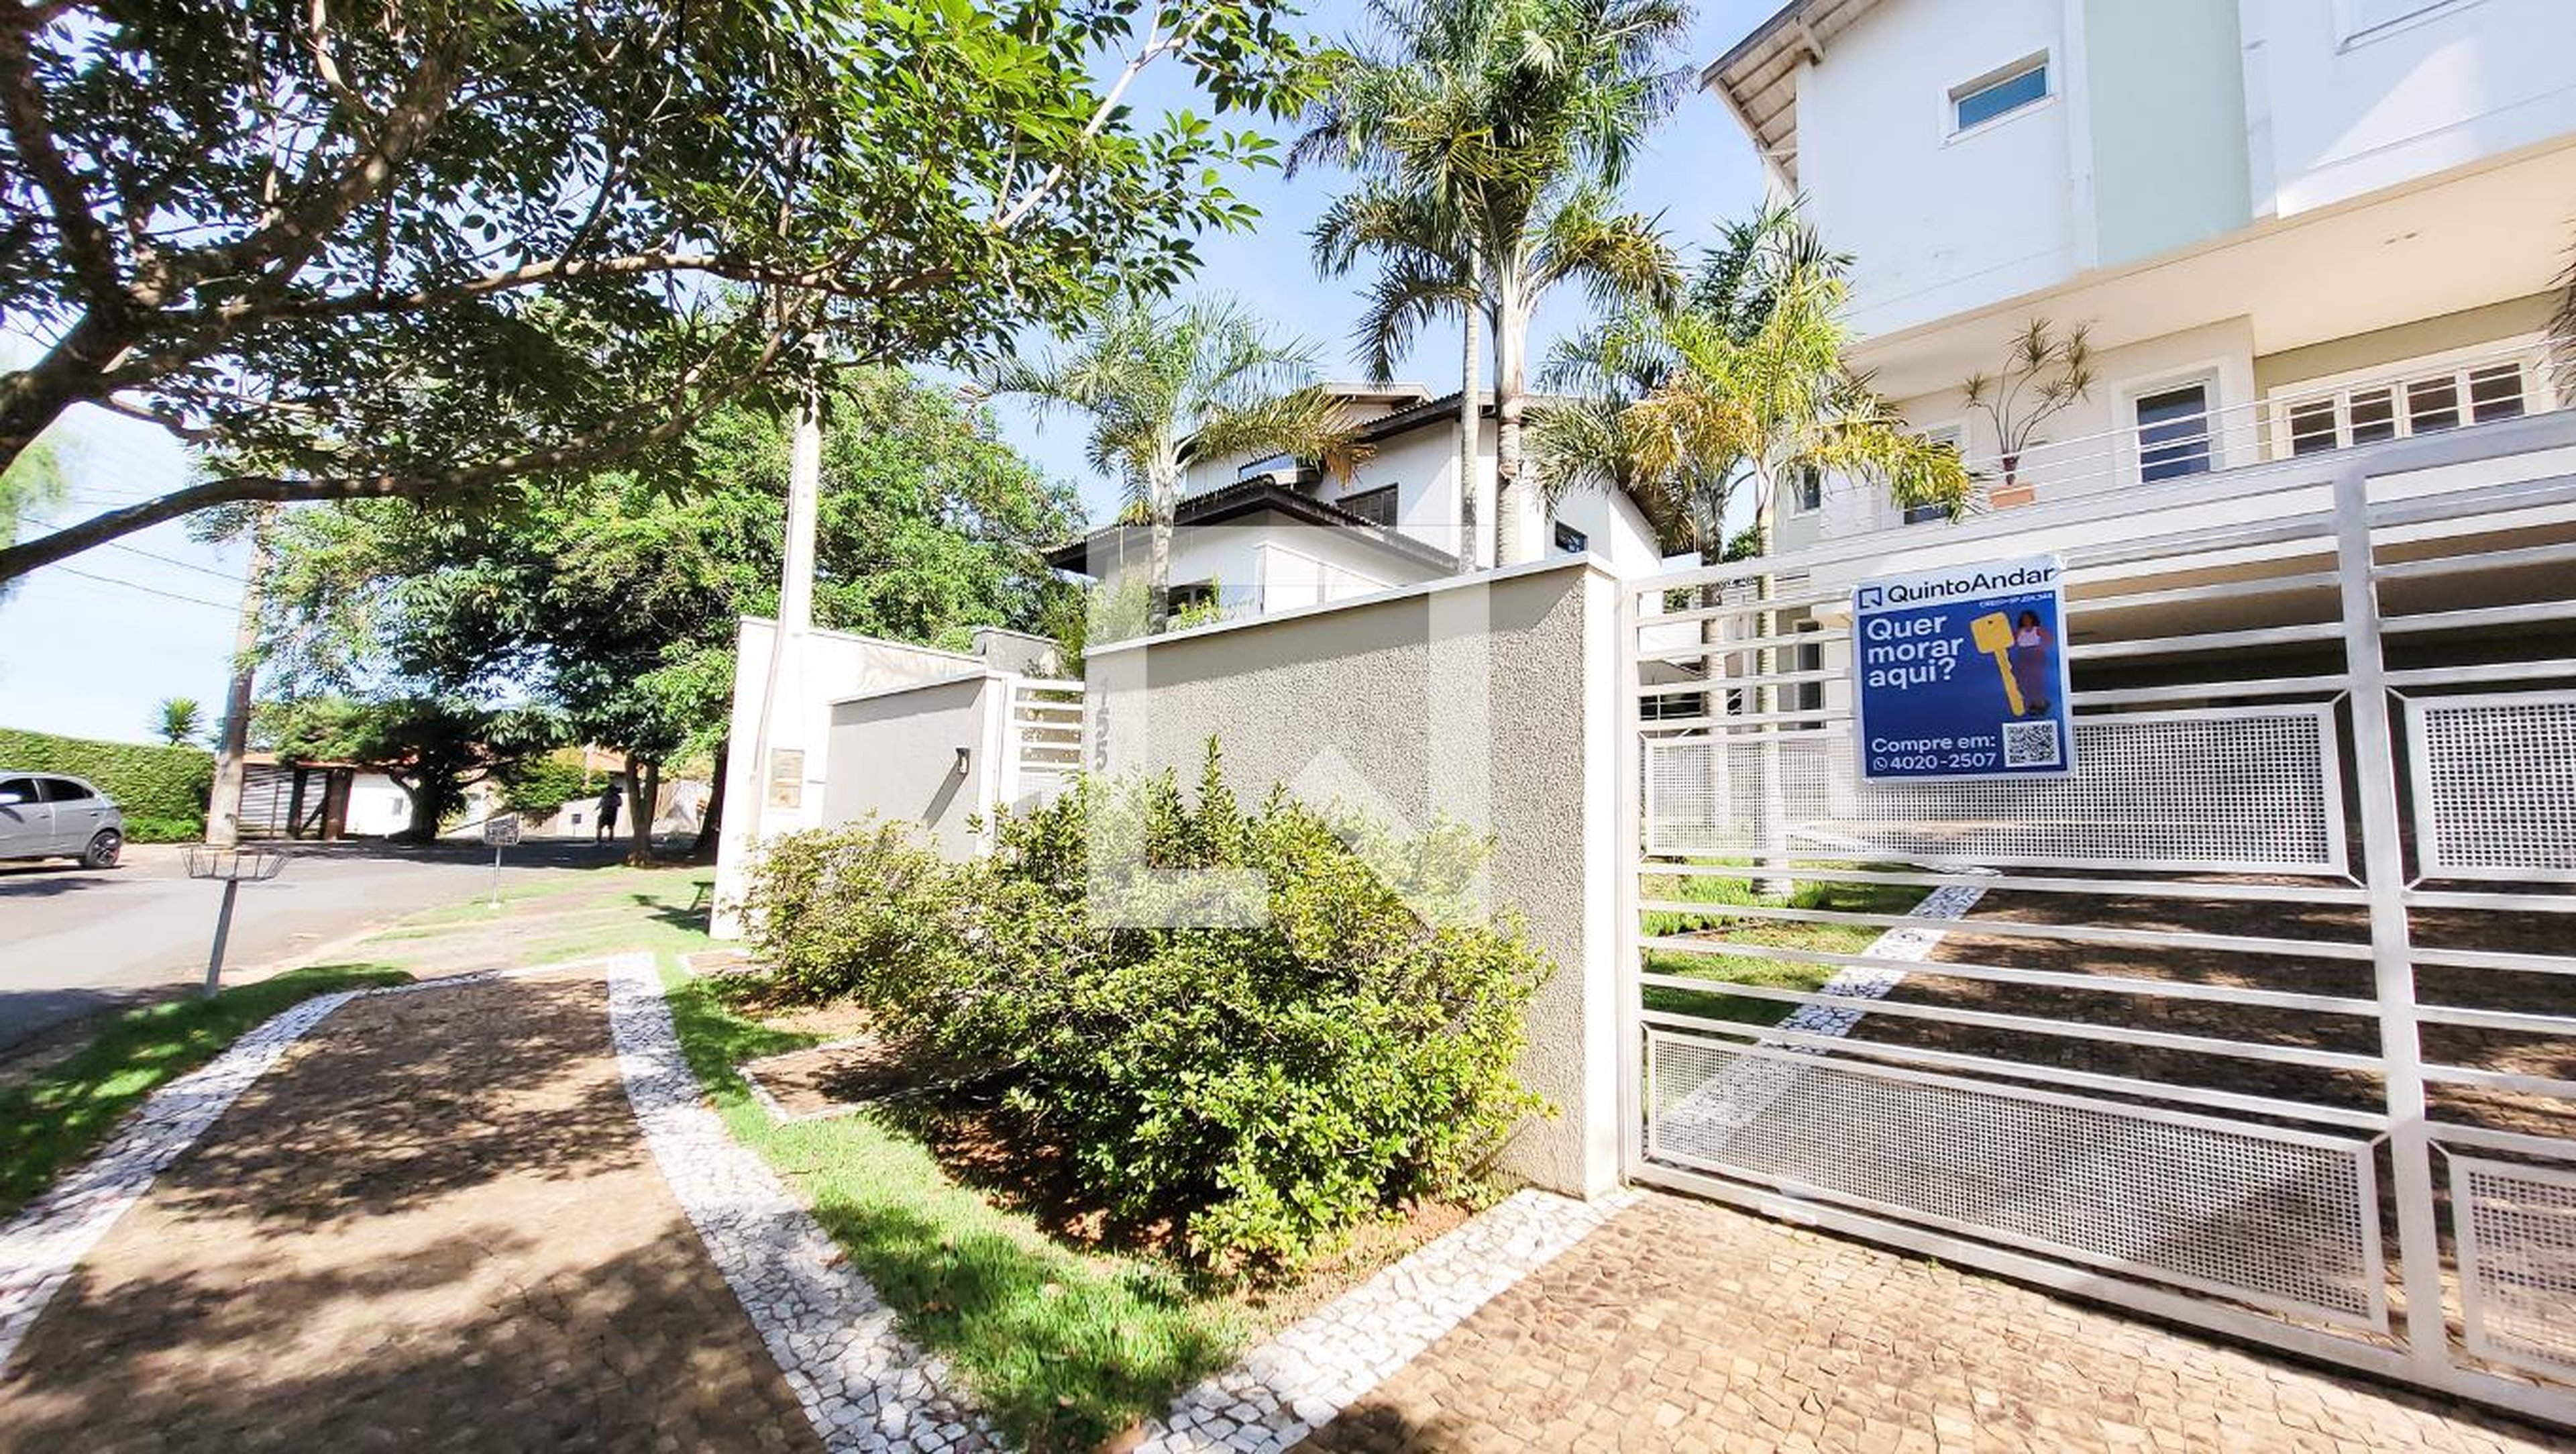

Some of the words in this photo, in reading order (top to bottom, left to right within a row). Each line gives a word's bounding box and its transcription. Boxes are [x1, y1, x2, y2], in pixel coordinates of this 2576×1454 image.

[1888, 568, 2055, 603] QuintoAndar
[1867, 615, 1947, 641] Quer
[1868, 638, 1964, 664] morar
[1868, 657, 1956, 690] aqui?
[1872, 737, 1953, 754] Compre
[1957, 735, 1996, 749] em:
[1890, 752, 1997, 770] 4020-2507
